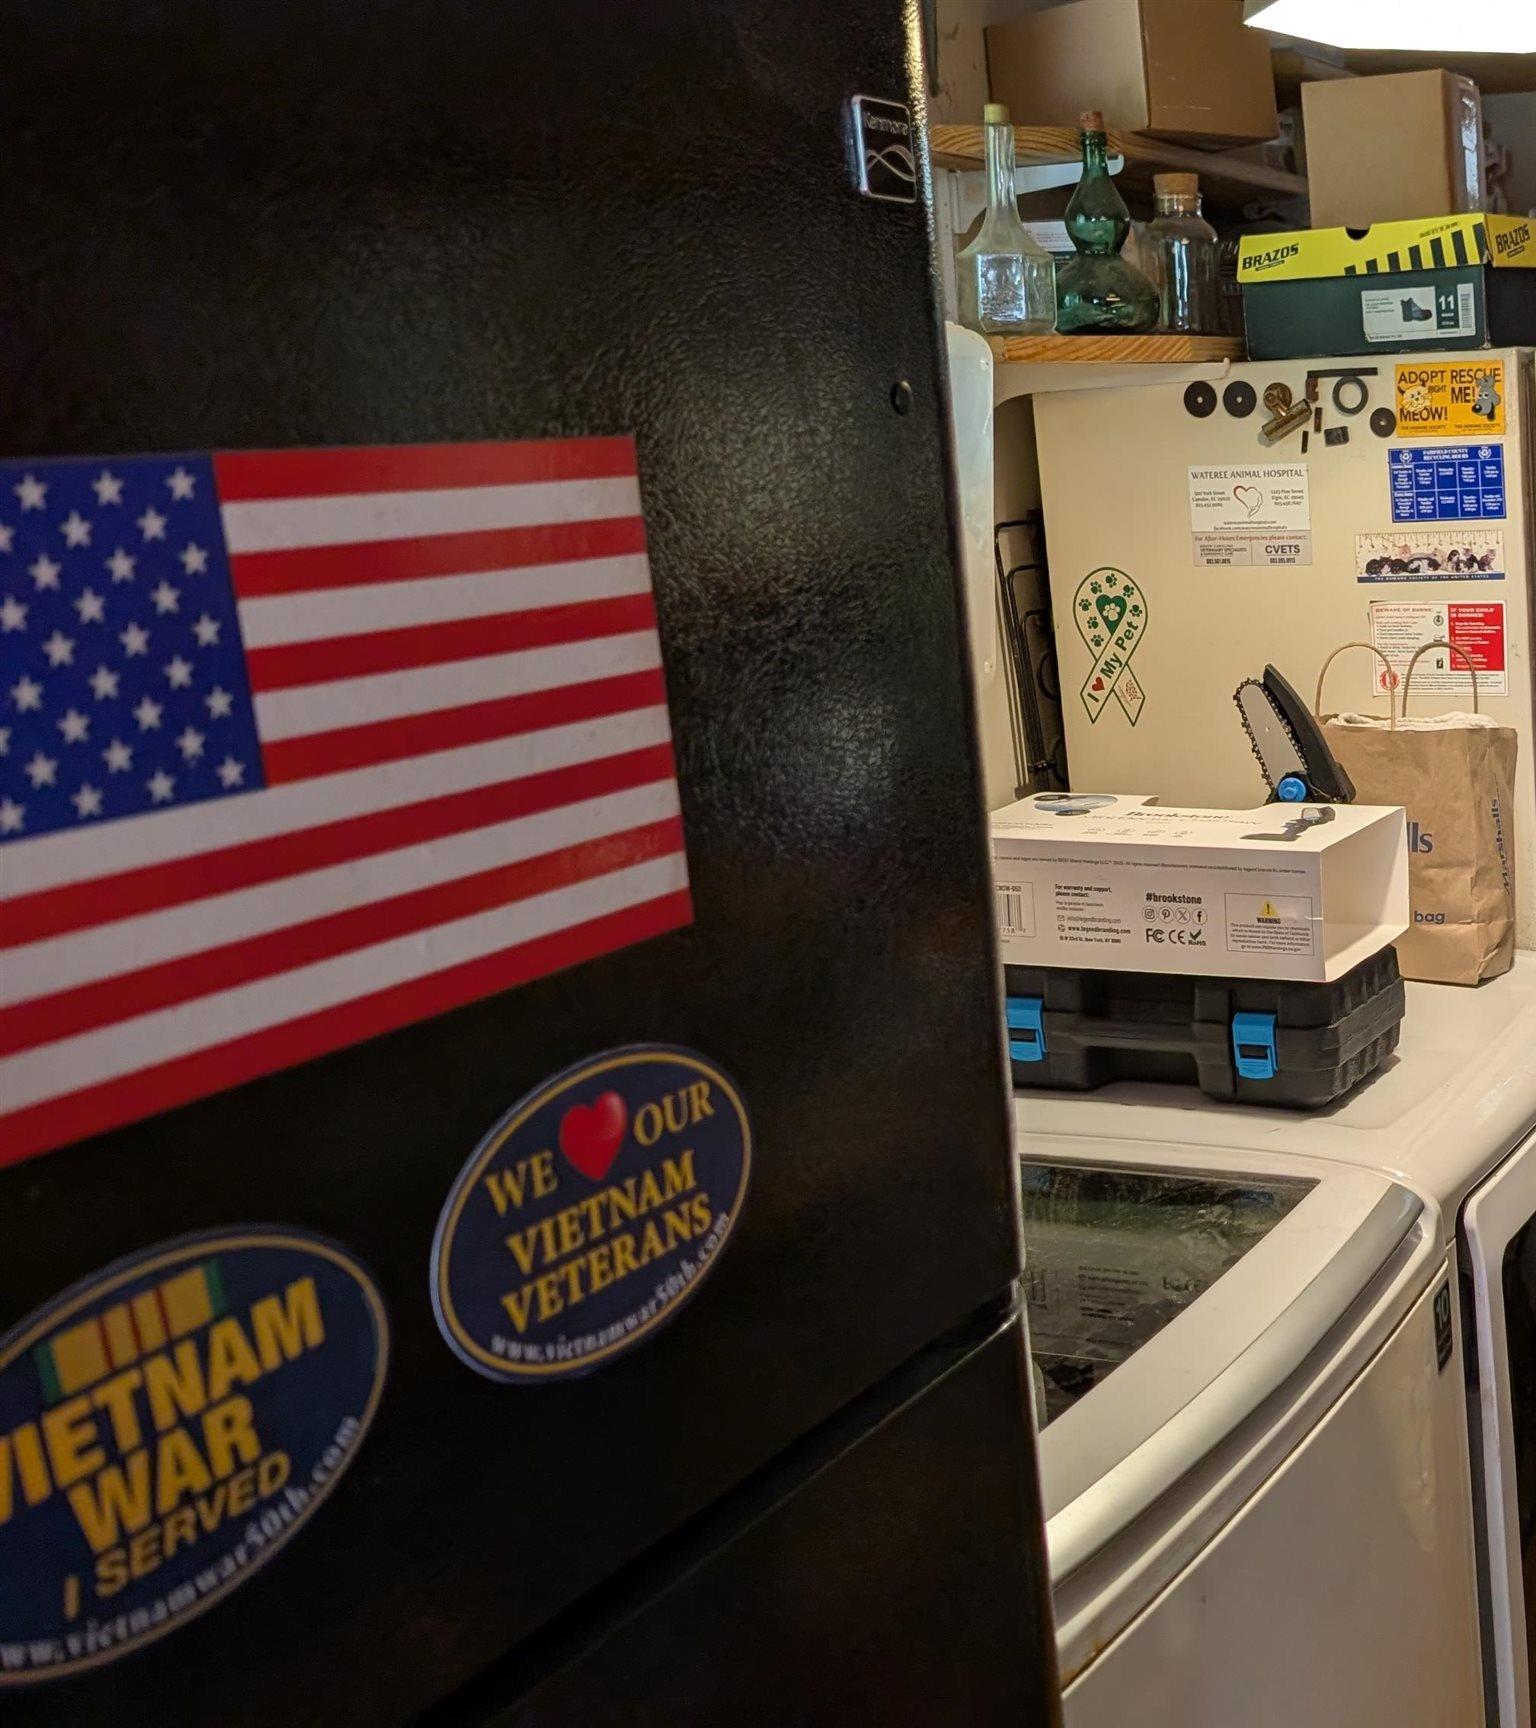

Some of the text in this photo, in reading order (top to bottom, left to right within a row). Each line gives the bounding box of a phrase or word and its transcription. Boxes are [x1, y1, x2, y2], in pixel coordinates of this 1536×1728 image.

[1495, 224, 1531, 255] BRAZOS
[1242, 243, 1300, 271] BRAZOS
[1438, 294, 1455, 311] 11
[1398, 370, 1446, 384] ADOPT
[1428, 385, 1476, 404] RIGHT ME!
[1399, 406, 1448, 422] MEOW!
[1191, 469, 1304, 480] WATEREE ANIMAL HOSPITAL
[1265, 545, 1301, 554] CVETS
[1087, 620, 1139, 703] I My Pet
[1146, 892, 1202, 904] #brookstone
[1414, 910, 1445, 925] bag
[486, 1081, 715, 1219] WE OUR
[505, 1149, 698, 1275] VIETNAM
[502, 1193, 713, 1335] VETERANS
[64, 1393, 262, 1555] WAR
[64, 1451, 291, 1620] I SERVED
